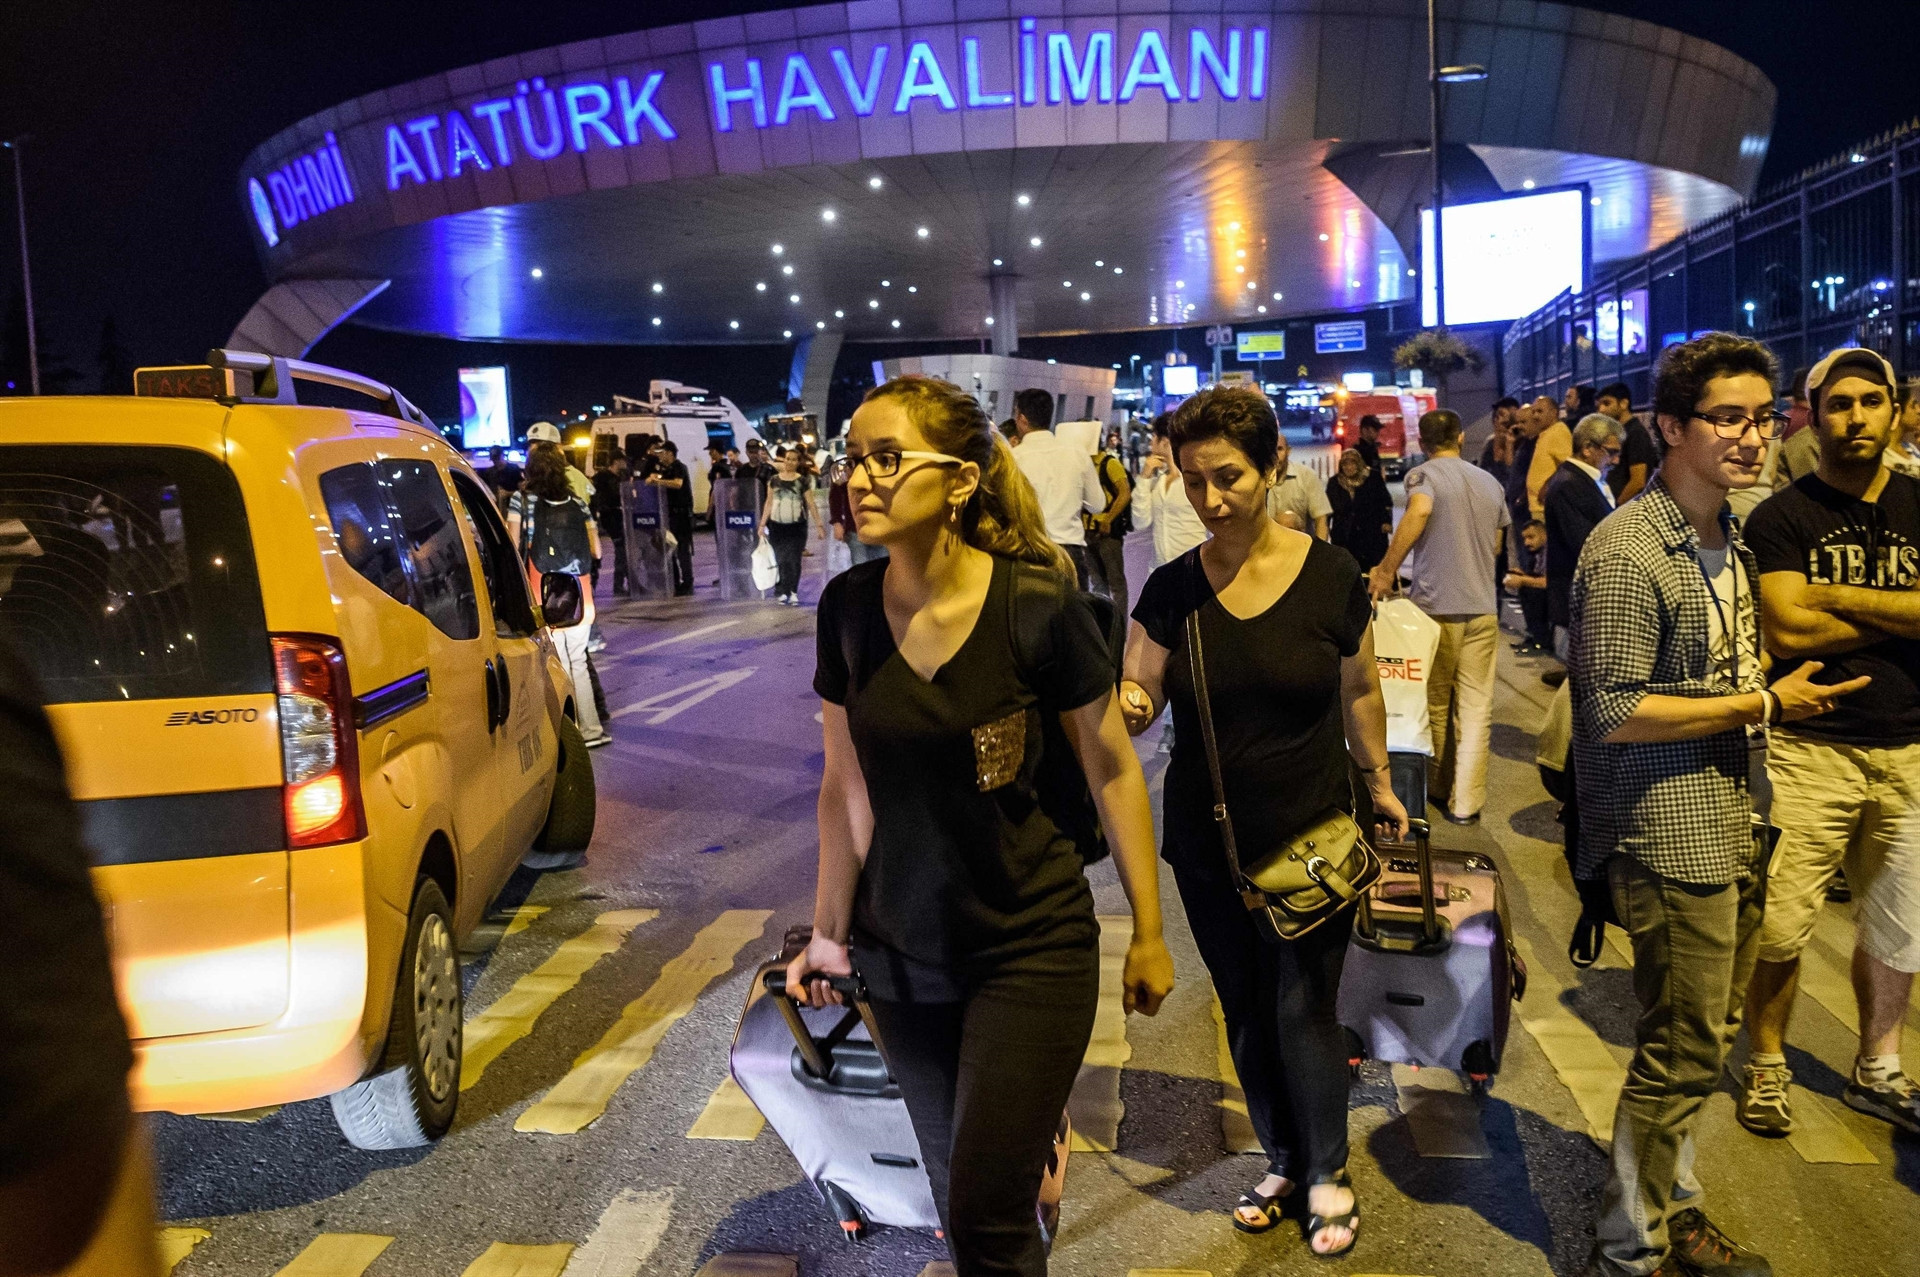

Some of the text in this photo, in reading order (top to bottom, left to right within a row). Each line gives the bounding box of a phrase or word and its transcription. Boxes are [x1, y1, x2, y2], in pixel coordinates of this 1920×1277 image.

[267, 17, 1268, 230] DHMİ ATATÜRK HAVALİMANI
